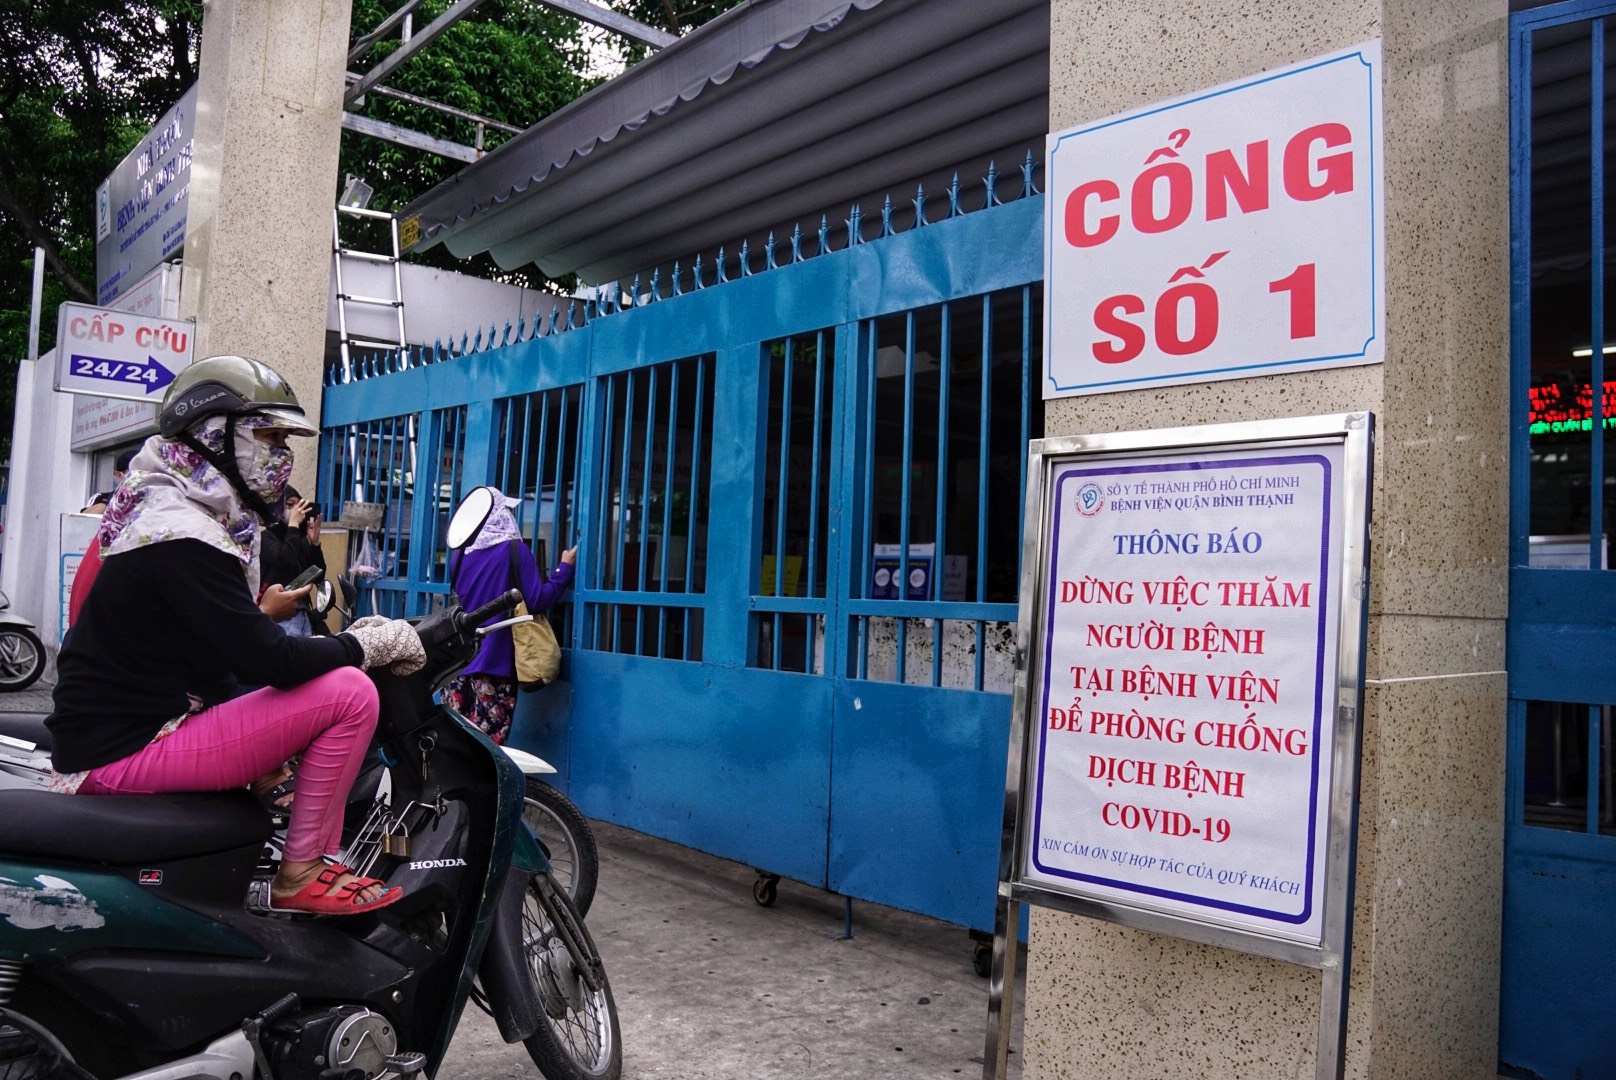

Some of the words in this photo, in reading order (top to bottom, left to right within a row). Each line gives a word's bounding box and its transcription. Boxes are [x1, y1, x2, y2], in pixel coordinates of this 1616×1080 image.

[1064, 122, 1354, 248] CỔNG
[1092, 250, 1231, 364] SỐ
[1269, 263, 1316, 340] 1
[70, 313, 125, 344] CẤP
[135, 325, 187, 354] CỨU
[76, 359, 159, 383] 24/24
[1107, 483, 1122, 496] SỞ
[1124, 485, 1131, 495] Y
[1134, 480, 1148, 494] TẾ
[1150, 480, 1190, 494] THÀNH
[1193, 476, 1217, 492] PHỐ
[1220, 475, 1238, 491] HỒ
[1240, 476, 1262, 490] CHÍ
[1265, 476, 1300, 489] MINH
[1111, 498, 1141, 513] BỆNH
[1145, 496, 1172, 512] VIỆN
[1175, 495, 1210, 511] QUẬN
[1212, 494, 1243, 508] BÌNH
[1247, 494, 1294, 509] THẠNH
[1113, 529, 1200, 555] THÔNG
[1207, 527, 1263, 554] BÁO
[1060, 575, 1134, 605] DỪNG
[1142, 575, 1210, 612] VIỆC
[1217, 575, 1312, 608] THĂM
[1086, 620, 1175, 651] NGƯỜI
[1182, 621, 1265, 659] BỆNH
[1071, 666, 1114, 697] TẠI
[1121, 664, 1197, 701] BỆNH
[1206, 670, 1280, 709] VIỆN
[1049, 697, 1083, 733] ĐỂ
[1089, 709, 1186, 744] PHÒNG
[1194, 712, 1308, 756] CHỐNG
[1087, 755, 1156, 788] DỊCH
[1163, 760, 1246, 799] BỆNH
[1102, 802, 1231, 843] COVID-19
[409, 858, 467, 871] HONDA
[1042, 838, 1062, 851] XIN
[1063, 841, 1089, 857] CÁM
[1091, 846, 1109, 860] ƠN
[1111, 850, 1128, 866] SỰ
[1129, 853, 1157, 870] HỢP
[1159, 858, 1184, 874] TÁC
[1186, 861, 1214, 880] CỦA
[1217, 870, 1248, 885] QUÝ
[1249, 876, 1301, 896] KHÁCH
